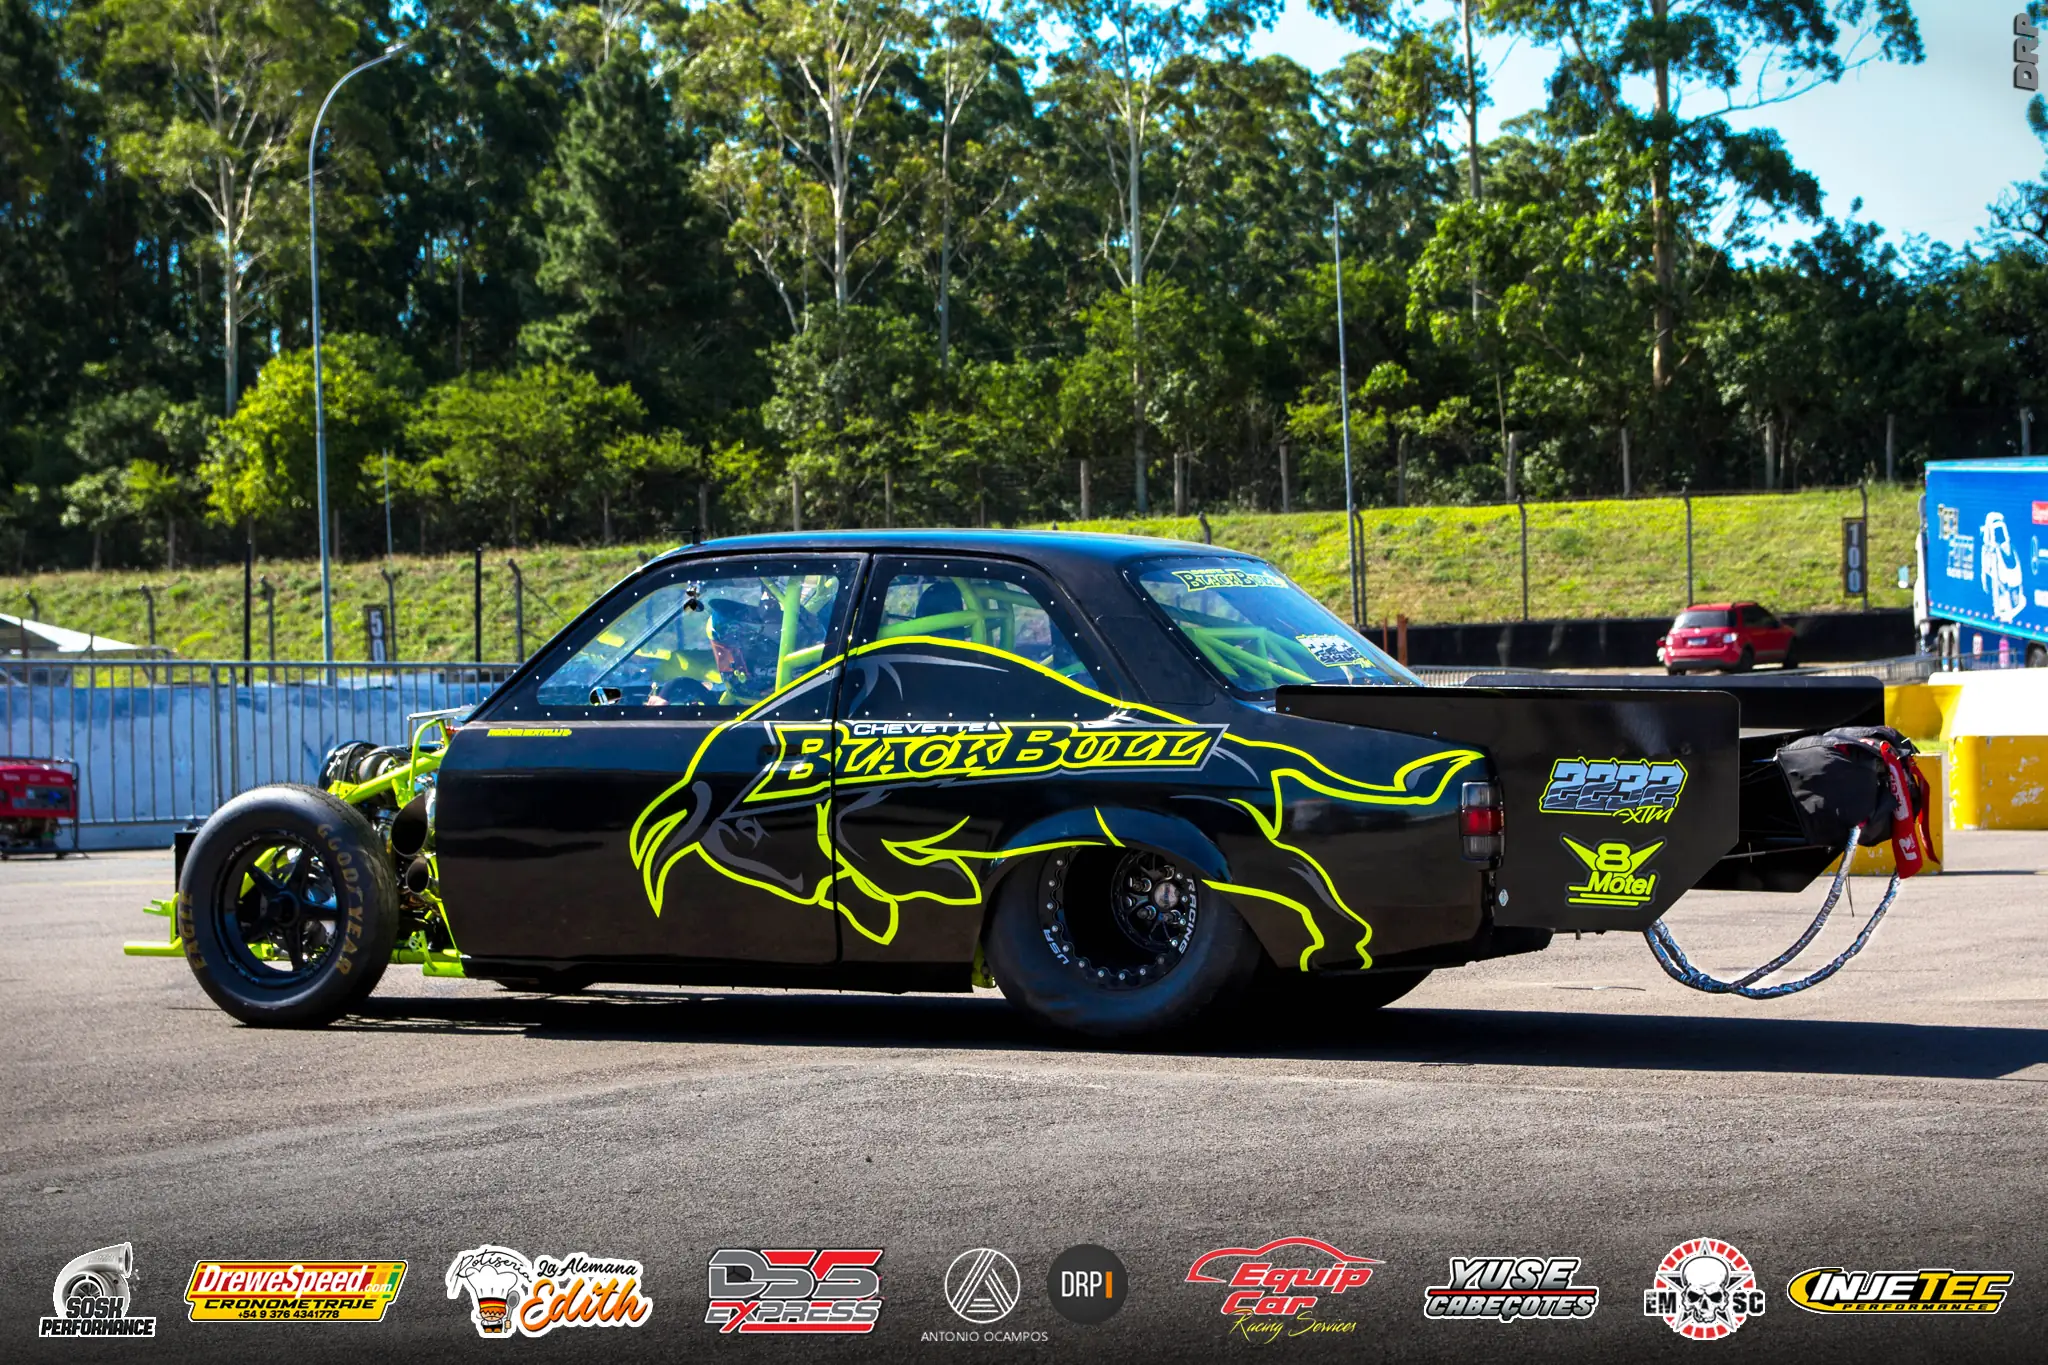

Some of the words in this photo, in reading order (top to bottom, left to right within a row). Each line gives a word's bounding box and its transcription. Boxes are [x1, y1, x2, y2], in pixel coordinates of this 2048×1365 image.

[1848, 523, 1861, 593] 100
[370, 610, 386, 664] 50
[853, 723, 987, 736] CHEVETTE
[743, 723, 1010, 803] BLACK
[992, 721, 1206, 770] BULL
[1542, 759, 1687, 812] 2232
[1588, 870, 1656, 895] Motel
[1178, 877, 1197, 955] RACING
[1043, 928, 1070, 965] USA
